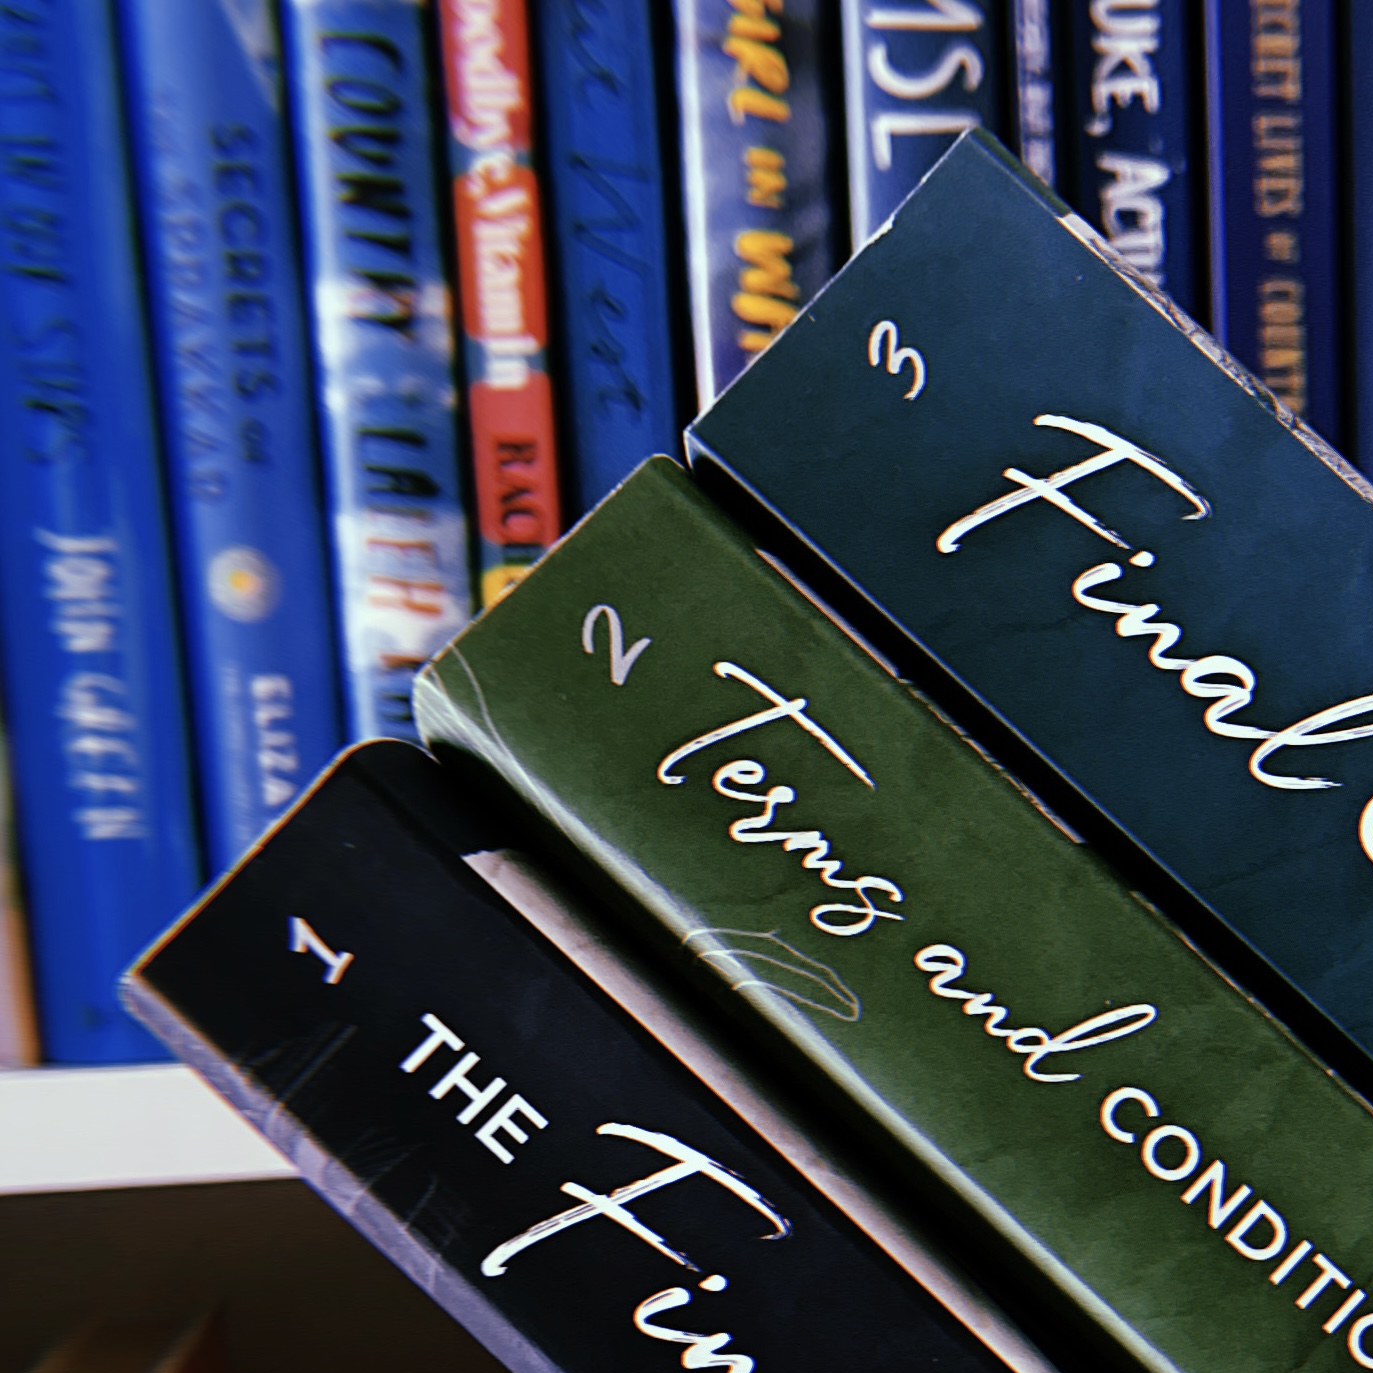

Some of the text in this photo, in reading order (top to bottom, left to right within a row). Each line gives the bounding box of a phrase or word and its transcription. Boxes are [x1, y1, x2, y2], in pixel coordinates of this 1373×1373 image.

[208, 121, 280, 399] SECRETS
[318, 28, 416, 348] COUNTRY
[868, 320, 928, 400] 3
[34, 527, 149, 839] JOHN GREEN
[581, 604, 652, 686] 2
[287, 915, 354, 985] 1
[656, 660, 905, 937] Terms
[914, 943, 1159, 1084] and
[399, 1012, 549, 1165] THE
